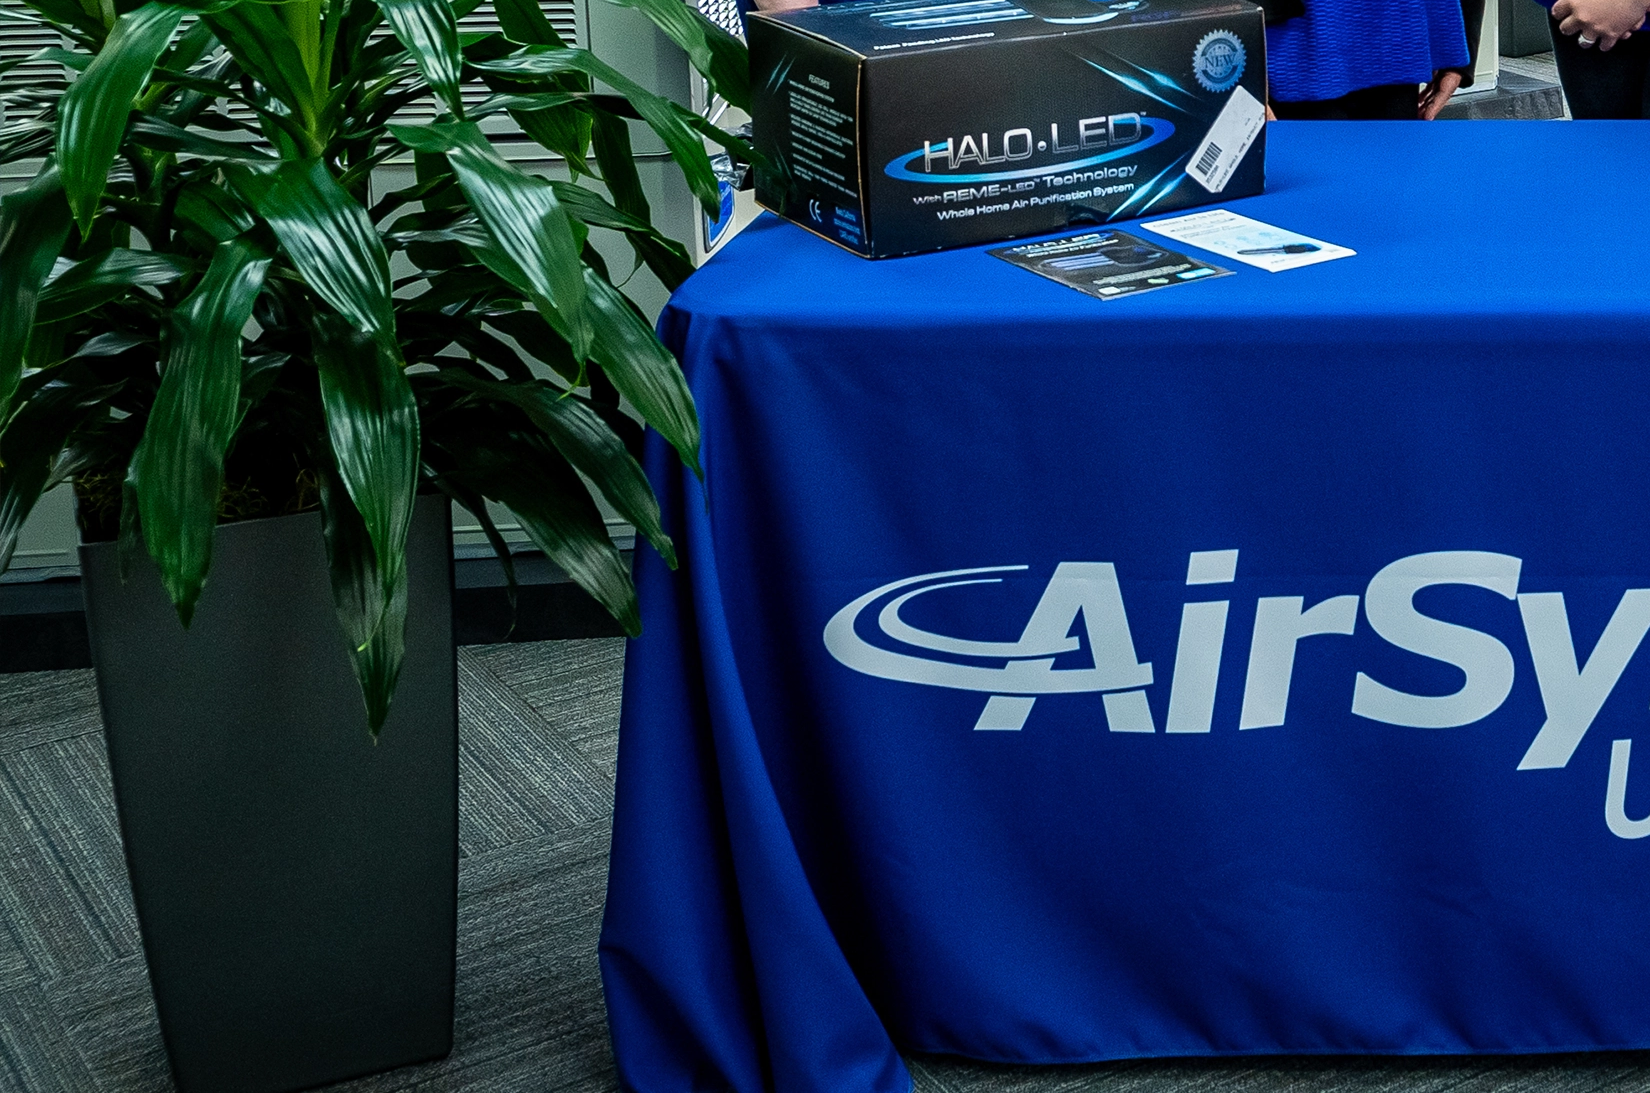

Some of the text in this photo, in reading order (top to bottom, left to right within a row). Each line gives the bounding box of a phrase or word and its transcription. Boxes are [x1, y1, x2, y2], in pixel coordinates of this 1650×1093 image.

[1203, 54, 1237, 69] NEW
[913, 195, 942, 205] With
[1042, 165, 1138, 188] Technology
[937, 183, 1135, 221] Whole Home Air Purification System
